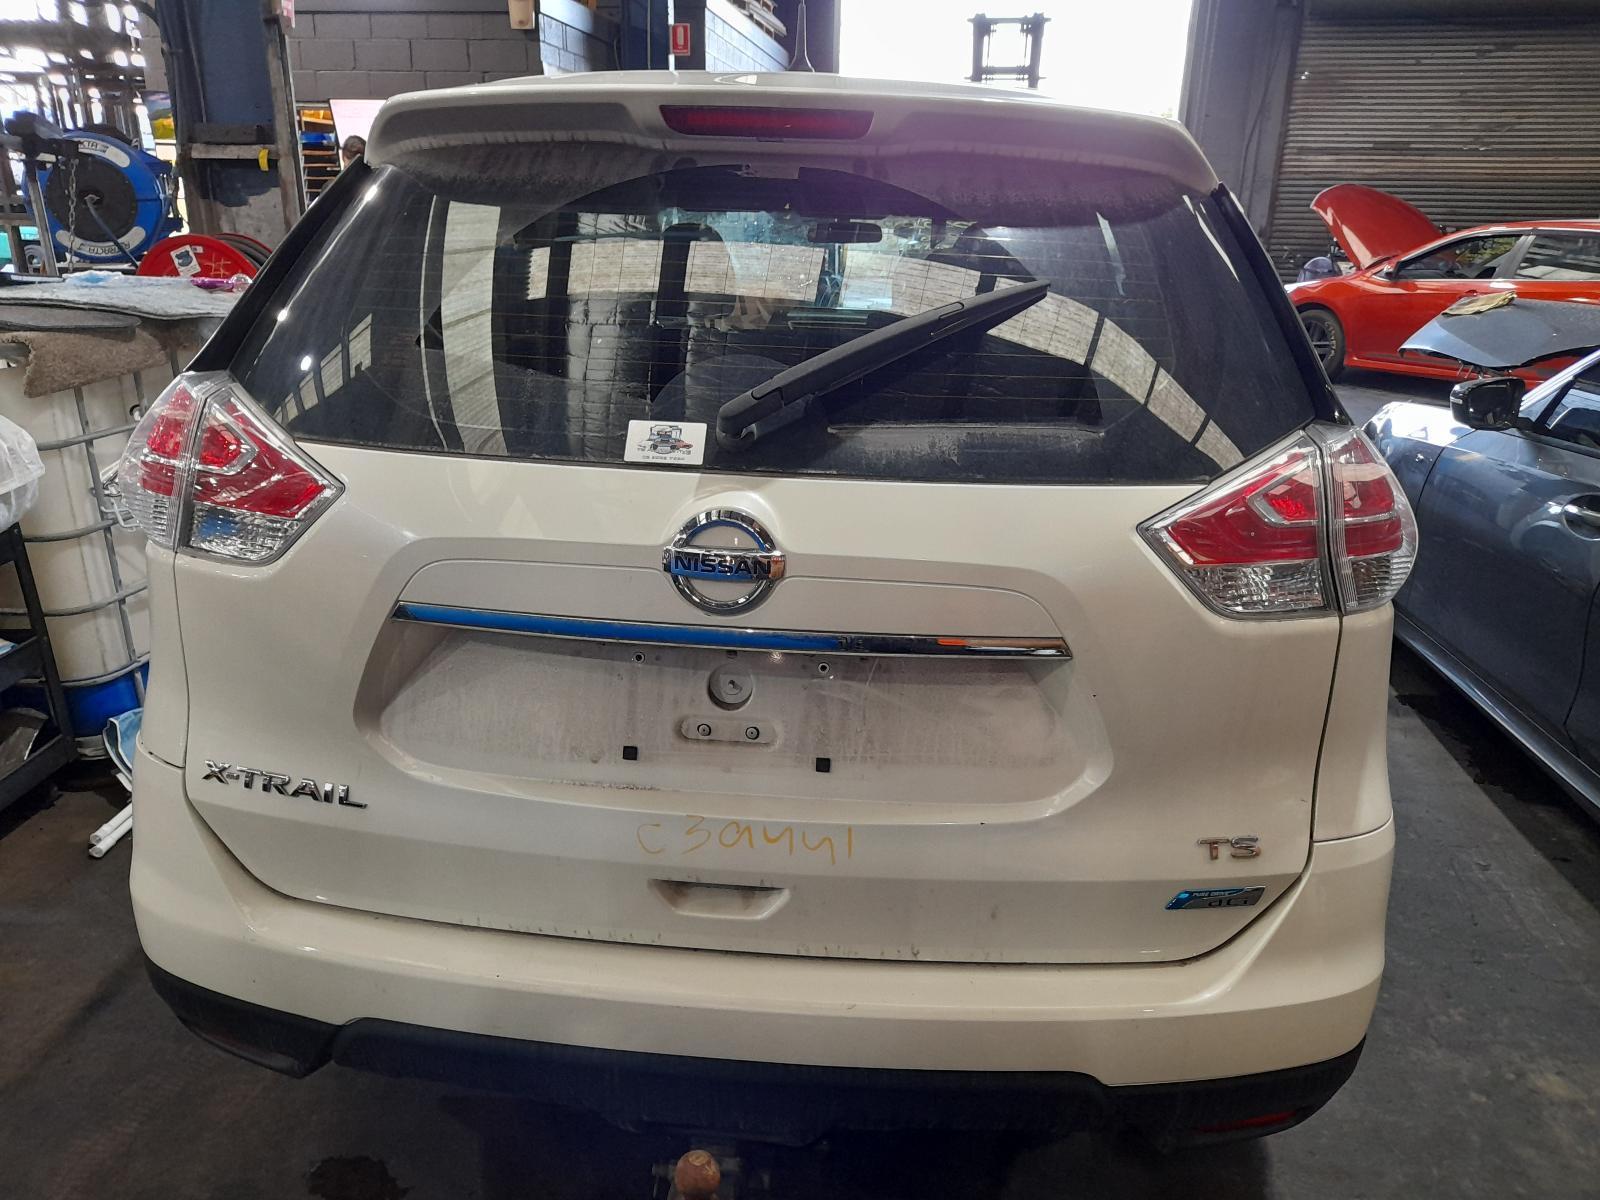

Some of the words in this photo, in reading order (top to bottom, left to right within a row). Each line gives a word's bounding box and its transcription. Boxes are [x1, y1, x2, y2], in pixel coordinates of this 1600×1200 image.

[674, 554, 771, 576] NISSAN
[201, 759, 368, 809] X-TRAIL
[1197, 836, 1261, 860] TS
